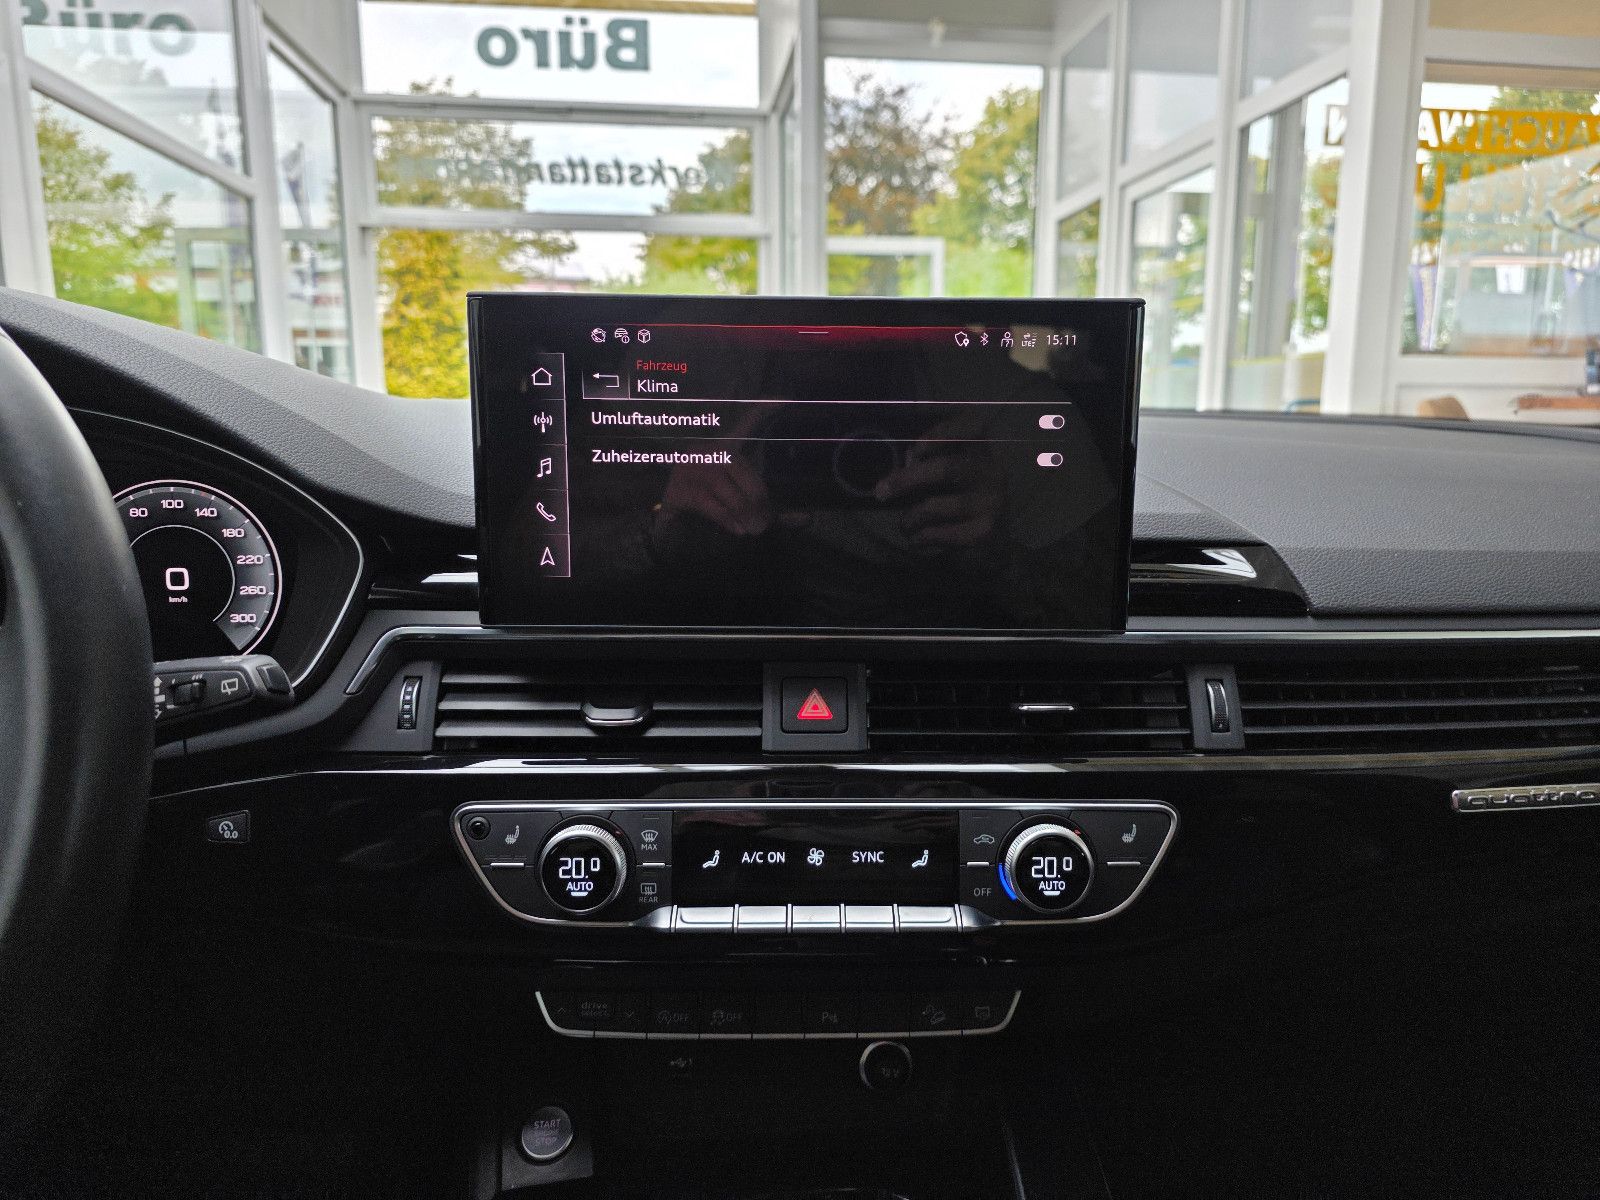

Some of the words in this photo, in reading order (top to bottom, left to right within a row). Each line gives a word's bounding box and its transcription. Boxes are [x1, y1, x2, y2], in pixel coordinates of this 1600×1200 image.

[1046, 334, 1077, 346] 15:11
[636, 360, 688, 374] Fahrzeug
[637, 379, 679, 394] Klima
[591, 411, 720, 427] Umluftautomatik
[592, 450, 732, 465] Zuheizerautomatik
[160, 499, 184, 509] 100
[129, 507, 148, 517] 80
[194, 507, 217, 517] 140
[221, 528, 244, 538] 180
[236, 555, 263, 565] 220
[165, 567, 190, 590] 0
[239, 585, 266, 595] 260
[229, 613, 257, 623] 300
[1467, 789, 1596, 810] quattro
[641, 843, 658, 851] MAX
[742, 852, 764, 864] A/C
[768, 852, 786, 863] ON
[852, 851, 885, 863] SYNC
[566, 881, 594, 892] AUTO
[1038, 880, 1066, 891] AUTO
[973, 887, 992, 897] OFF
[533, 1118, 562, 1130] START
